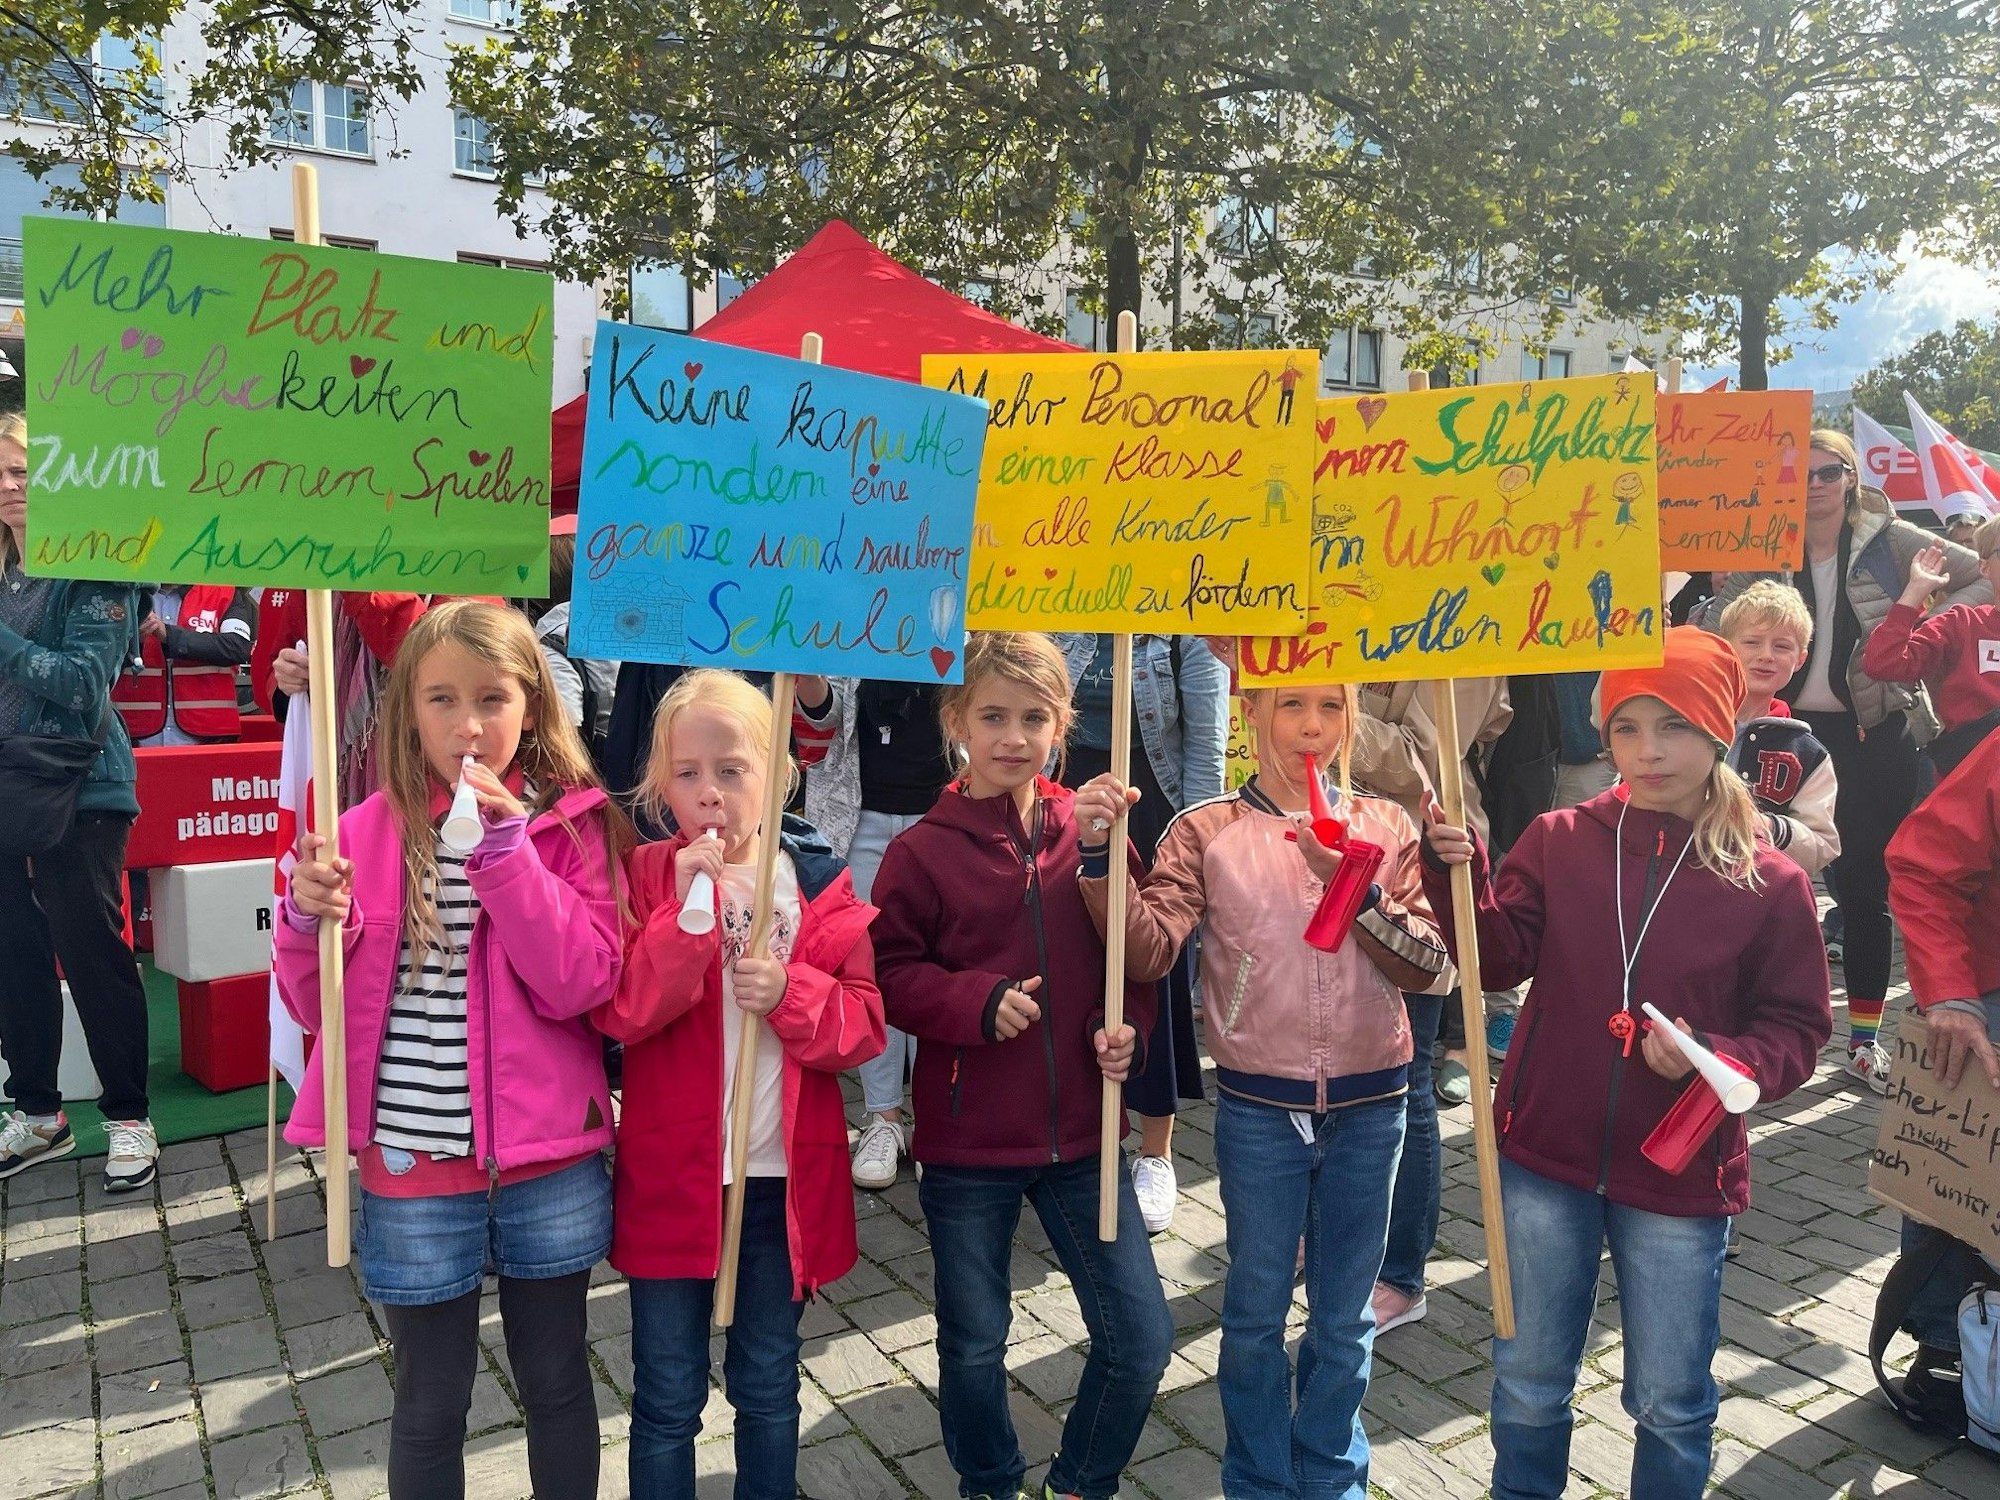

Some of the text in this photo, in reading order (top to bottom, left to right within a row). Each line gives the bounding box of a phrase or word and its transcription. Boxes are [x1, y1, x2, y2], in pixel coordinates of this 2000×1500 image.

[41, 243, 544, 376] Mehr Platz und
[608, 334, 750, 429] Keine
[1081, 360, 1271, 429] Personal
[995, 434, 1244, 486] einer Klasse
[1413, 393, 1654, 488] Schulplatz
[1866, 446, 1918, 476] GE
[401, 438, 550, 517] Spielen
[595, 437, 909, 507] sondern eine
[34, 515, 163, 572] und
[587, 523, 732, 580] ganze
[749, 512, 845, 576] und
[1022, 496, 1092, 548] alle
[967, 560, 1134, 616] dividuell
[1133, 586, 1174, 613] zu
[1357, 586, 1502, 661] wollen
[1517, 570, 1653, 652] laufen
[211, 776, 281, 802] Mehr
[1753, 750, 1803, 805] D
[177, 811, 279, 842] pädago
[256, 907, 272, 931] R
[1900, 1120, 1958, 1152] nicht
